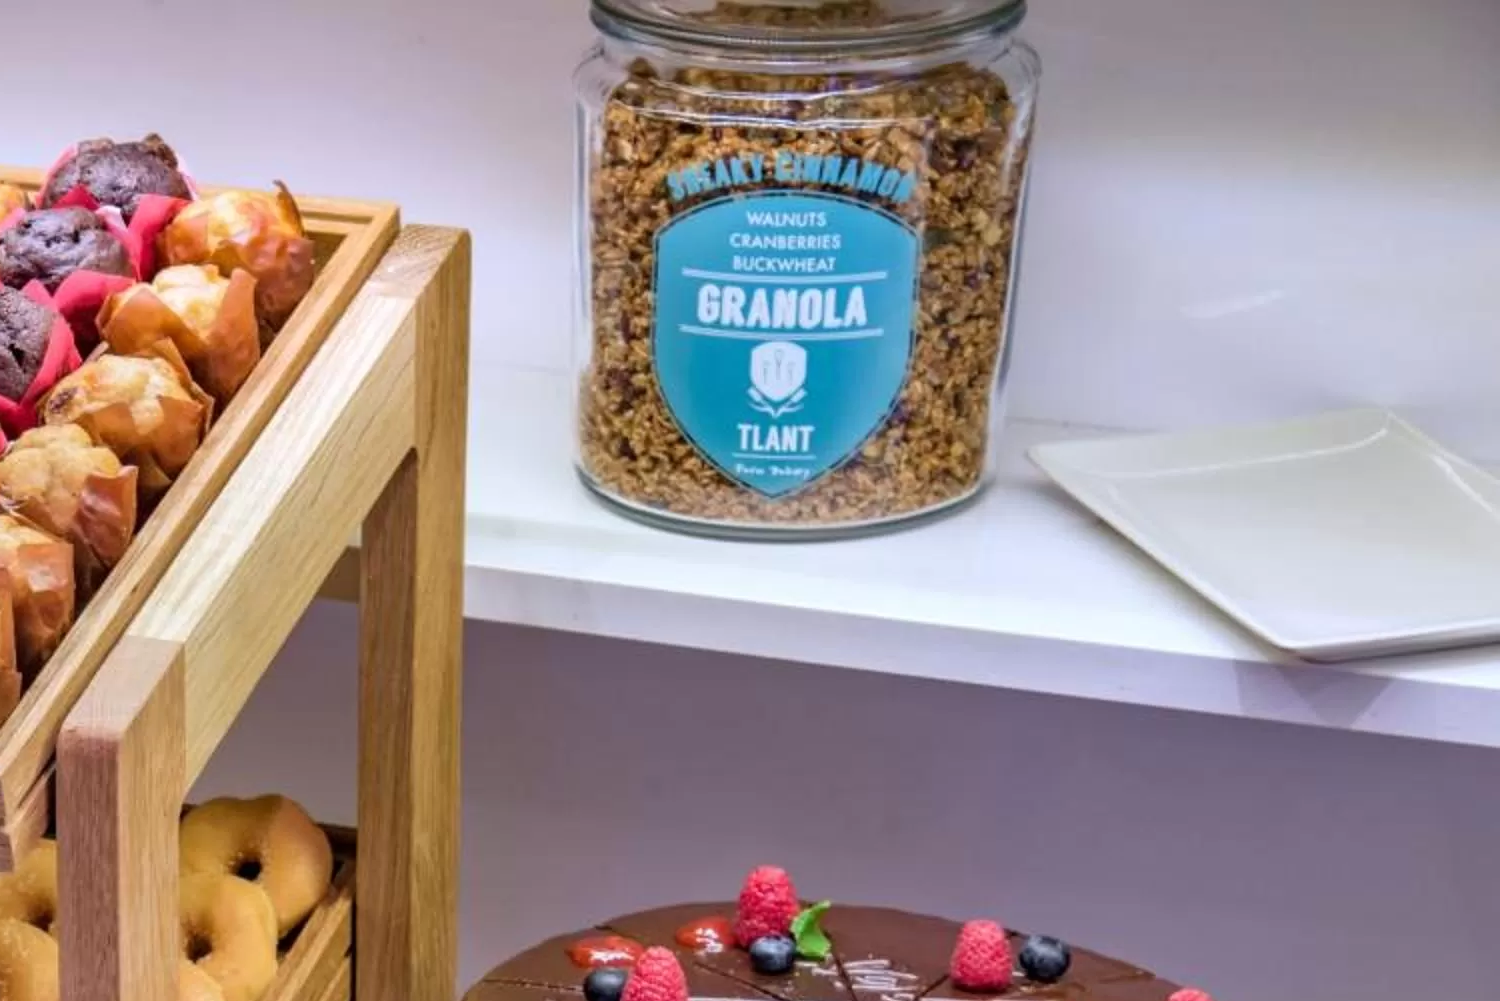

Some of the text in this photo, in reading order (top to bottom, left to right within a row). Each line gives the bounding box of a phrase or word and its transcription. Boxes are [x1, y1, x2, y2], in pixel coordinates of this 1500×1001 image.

[746, 211, 827, 228] WALNUTS
[729, 233, 842, 250] CRANBERRIES
[732, 256, 836, 272] BUCKWHEAT
[697, 283, 868, 330] GRANOLA
[736, 423, 816, 452] TLANT
